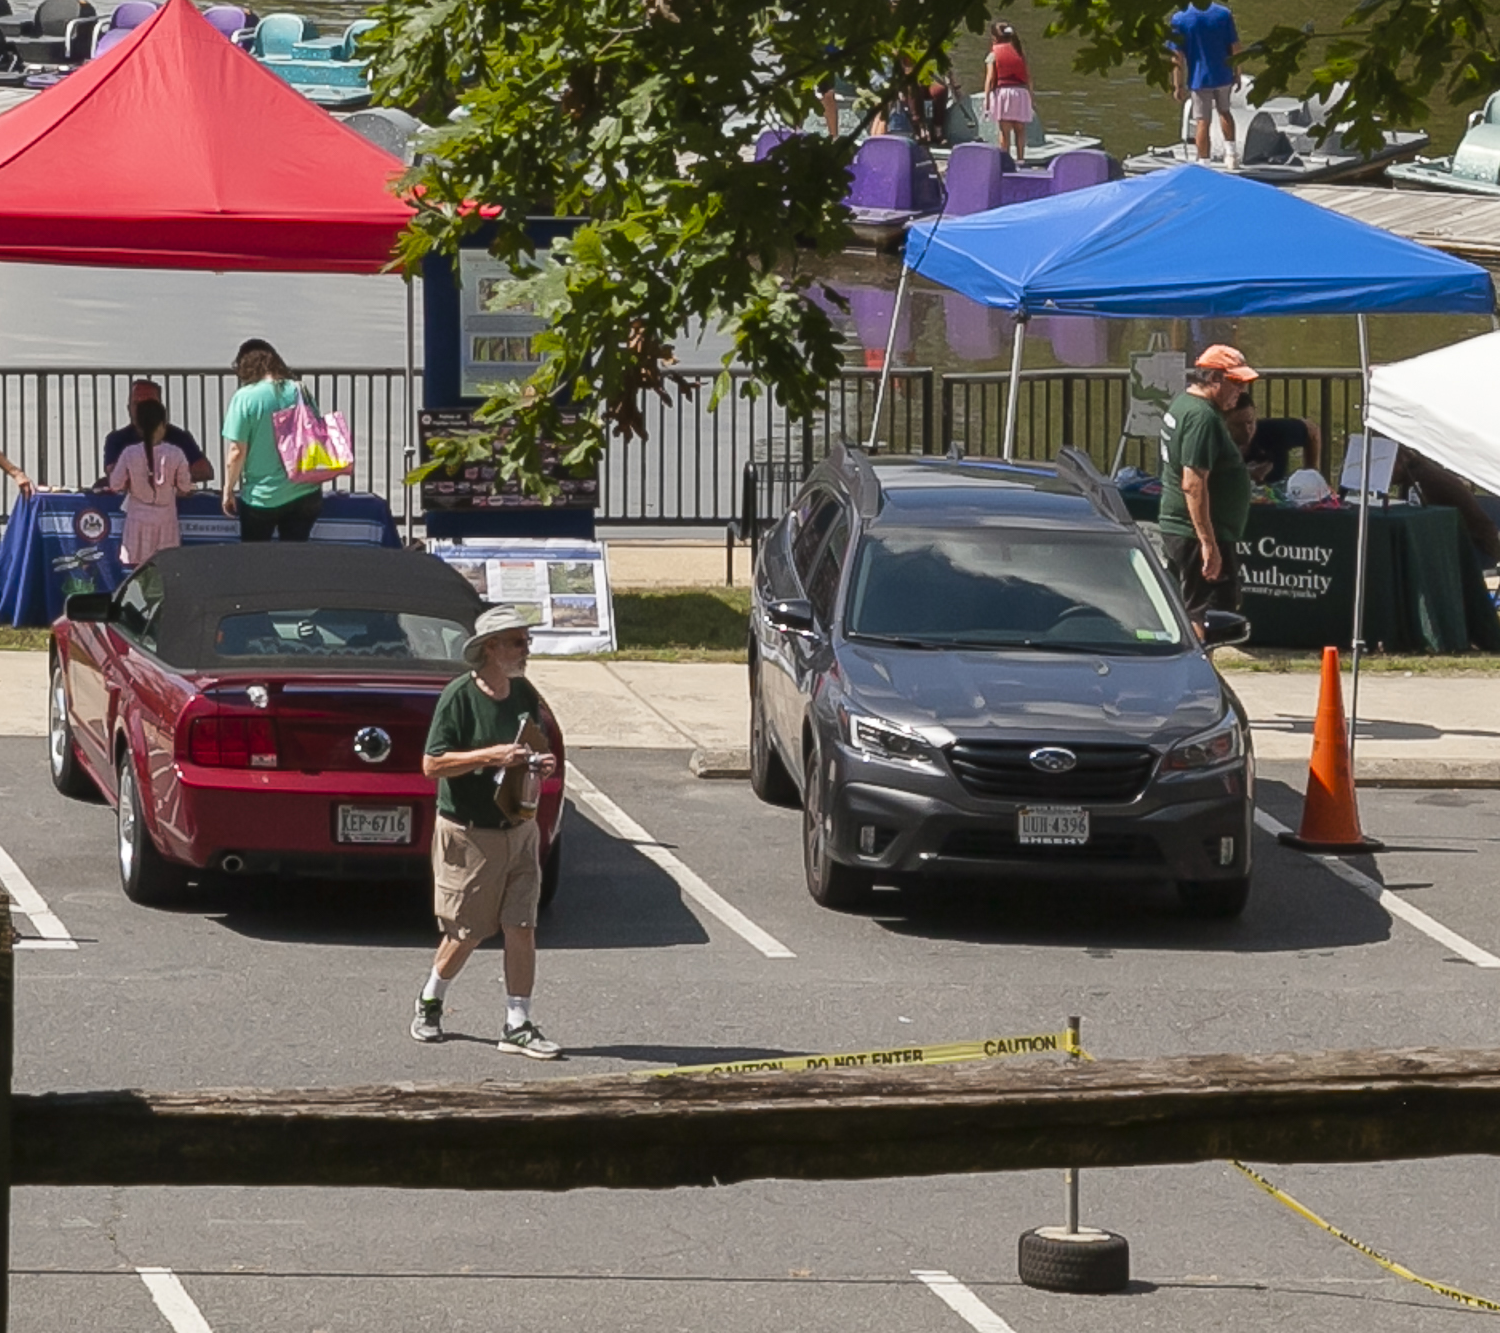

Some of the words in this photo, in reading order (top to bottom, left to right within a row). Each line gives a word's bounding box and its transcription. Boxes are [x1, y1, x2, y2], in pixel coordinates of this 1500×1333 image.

[1257, 536, 1334, 566] County
[1238, 563, 1333, 595] Authority
[1022, 816, 1088, 835] UUH-4396
[871, 1049, 924, 1066] ENTER
[983, 1035, 1057, 1056] CAUTION
